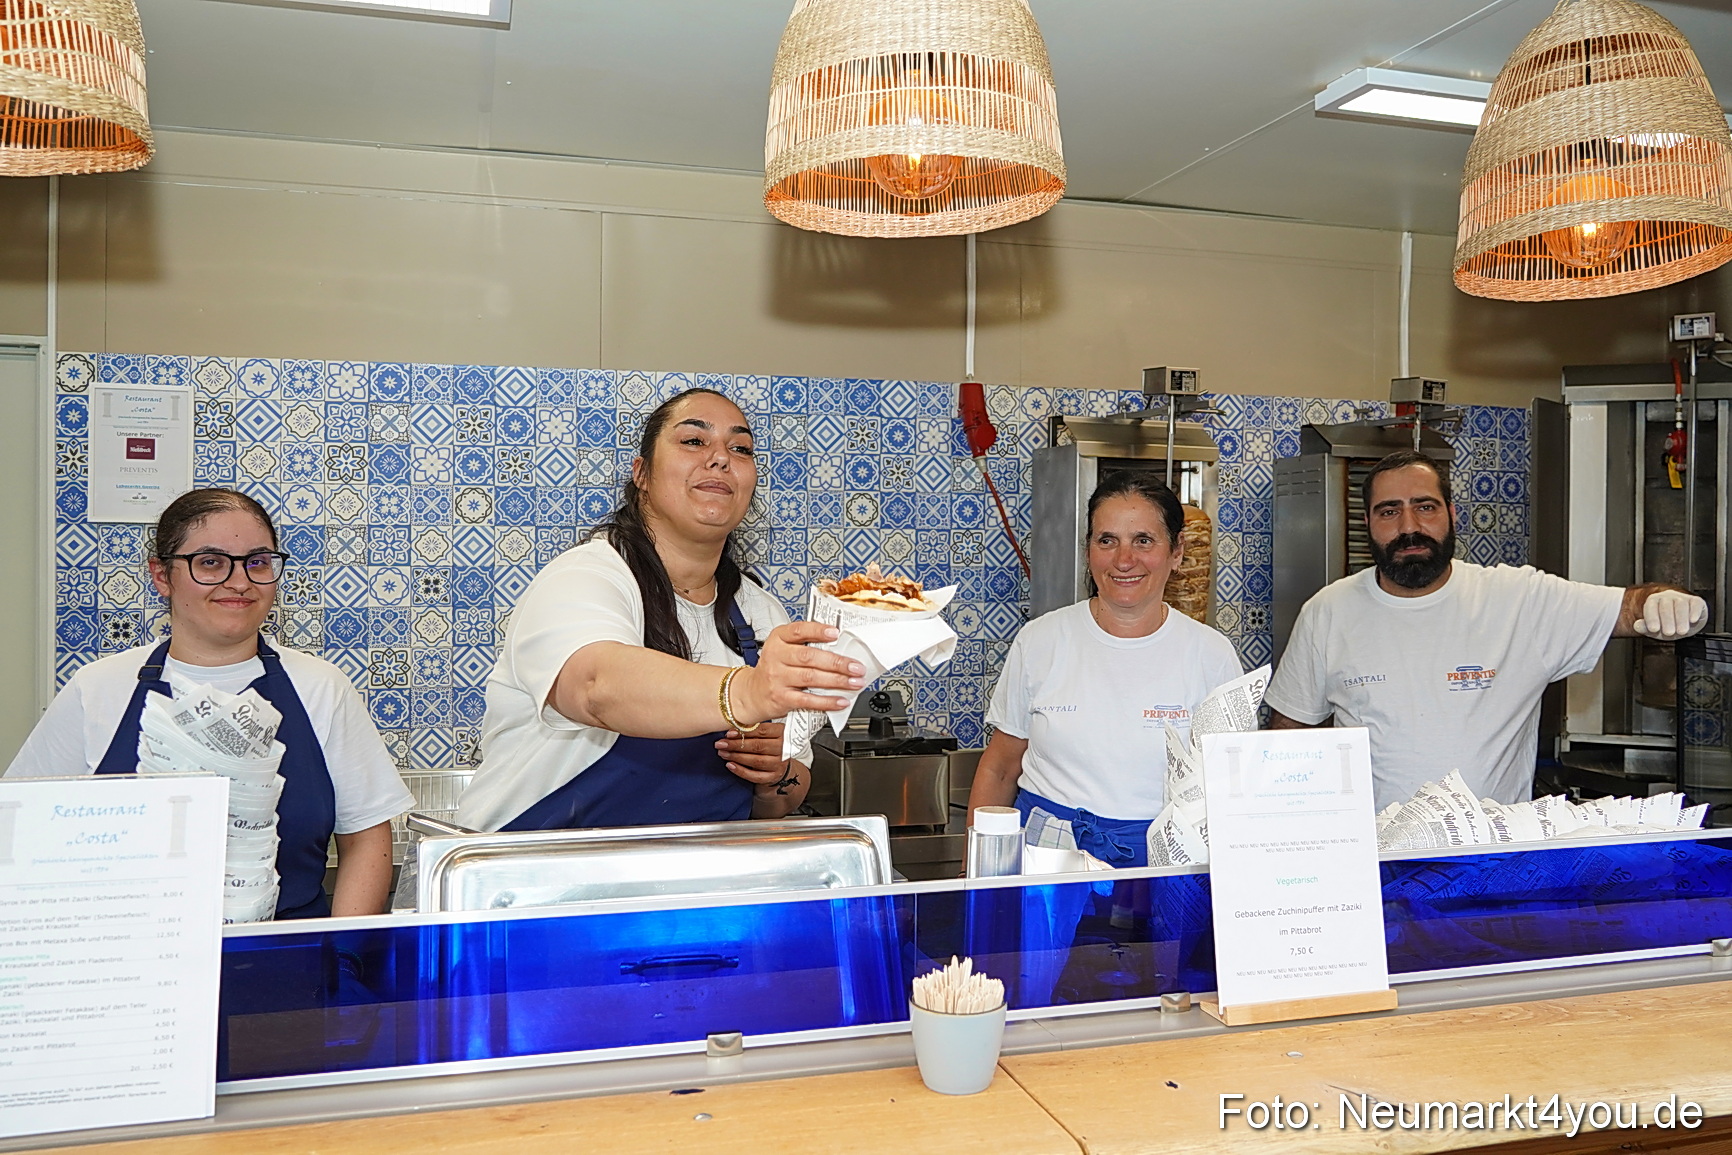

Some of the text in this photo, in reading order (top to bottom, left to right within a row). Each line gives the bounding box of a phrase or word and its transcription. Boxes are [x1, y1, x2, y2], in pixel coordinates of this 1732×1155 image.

[140, 431, 165, 440] Partner:
[119, 466, 159, 474] PREVENTIS
[1446, 668, 1497, 682] PREVENTIS
[1344, 674, 1387, 687] TSANTALI
[1262, 749, 1325, 764] Restaurant
[50, 803, 148, 822] Restaurant
[1276, 875, 1319, 887] Vegetarisch
[1234, 902, 1362, 919] Gebackene Zuchinipuffer mit Zaziki
[46, 922, 80, 930] Krautsalat
[1279, 925, 1322, 937] im Pittabrot
[102, 933, 131, 941] Pittabrot
[1290, 945, 1315, 957] 7,50 €
[5, 961, 40, 969] Krautsalat
[88, 955, 123, 963] Fladenbrot
[112, 974, 141, 983] Pittabrot
[100, 1003, 111, 1011] auf
[76, 1011, 105, 1019] Pittabrot
[12, 1030, 47, 1038] Krautsalat
[46, 1041, 77, 1049] Pittabrot
